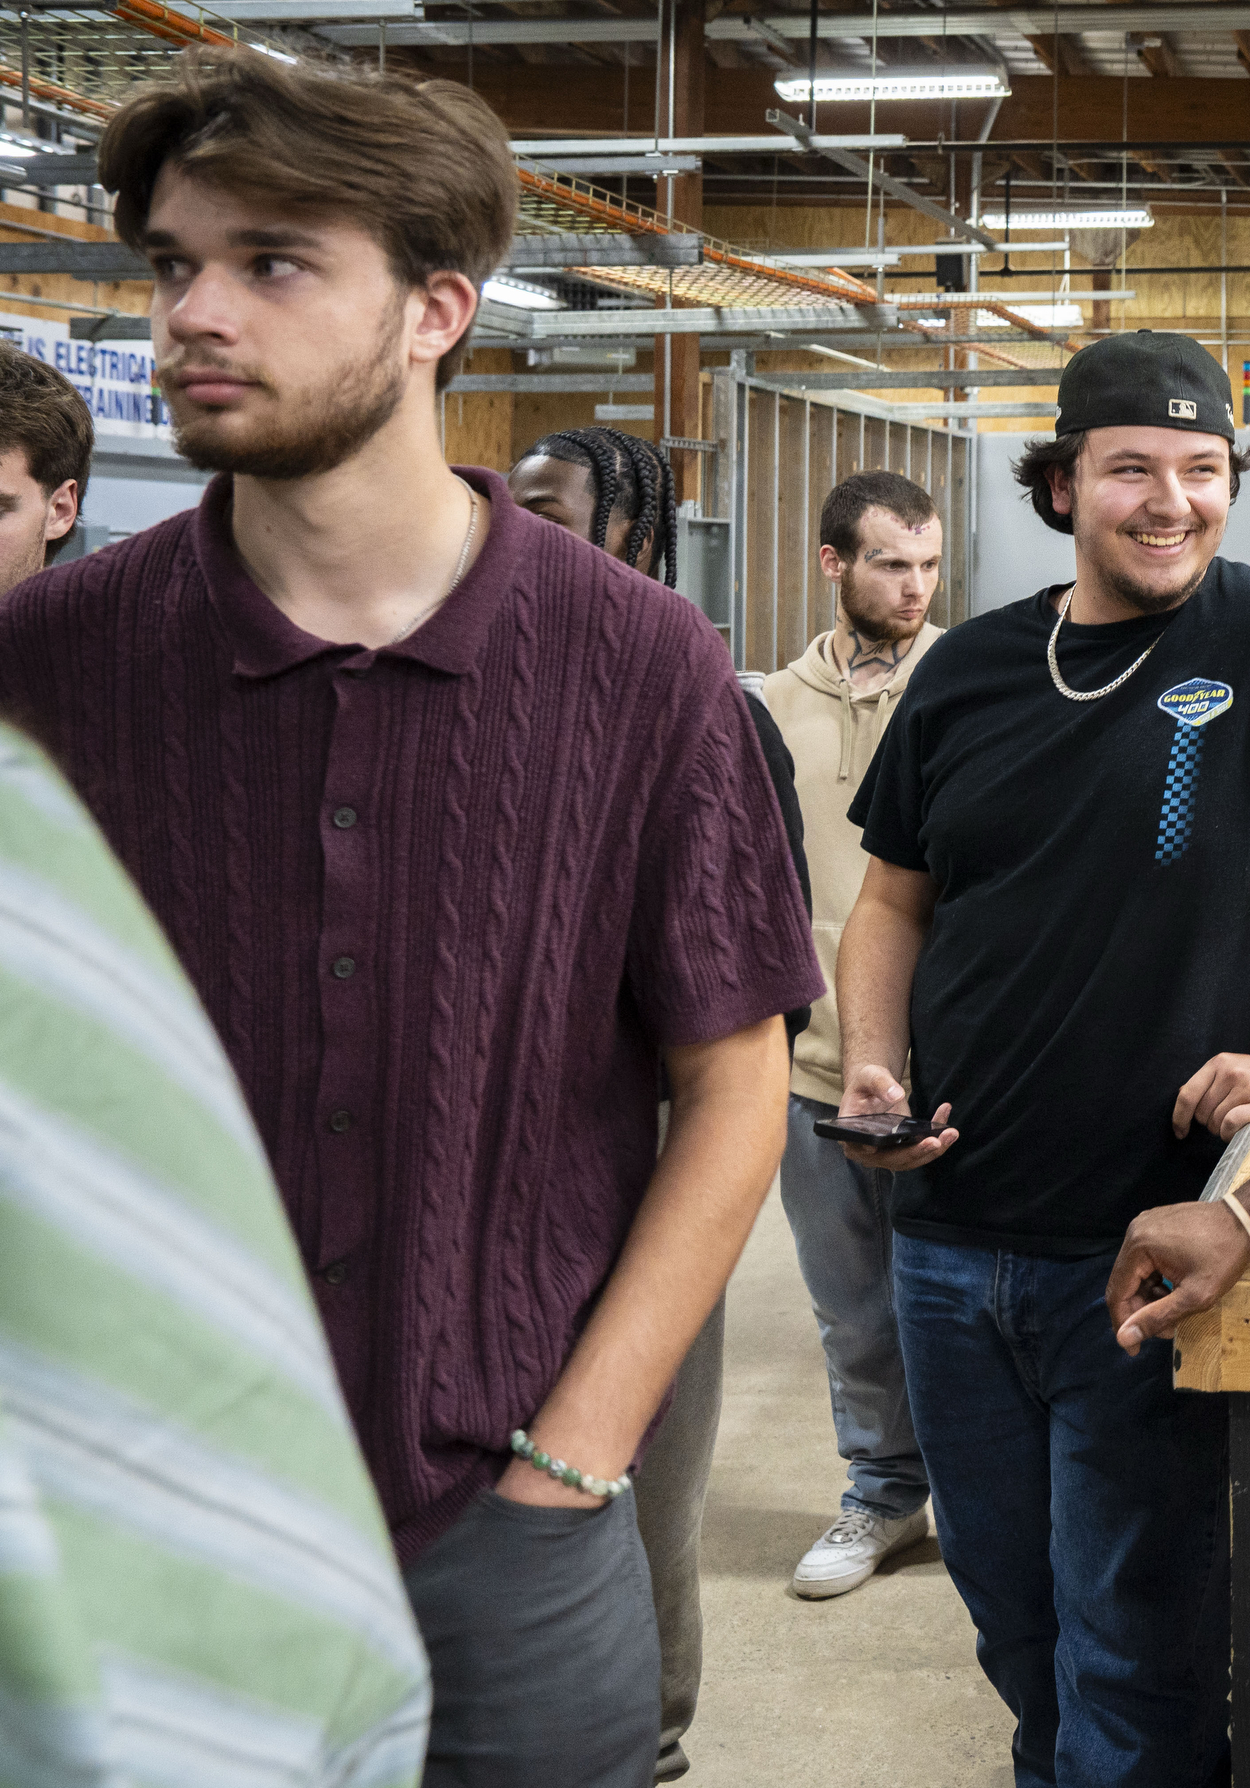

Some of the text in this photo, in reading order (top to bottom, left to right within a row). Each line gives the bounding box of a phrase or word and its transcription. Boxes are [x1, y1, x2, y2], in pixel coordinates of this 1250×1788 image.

[55, 341, 151, 385] ELECTRICA
[1163, 689, 1226, 703] GOODYEAR
[1177, 700, 1210, 715] 400
